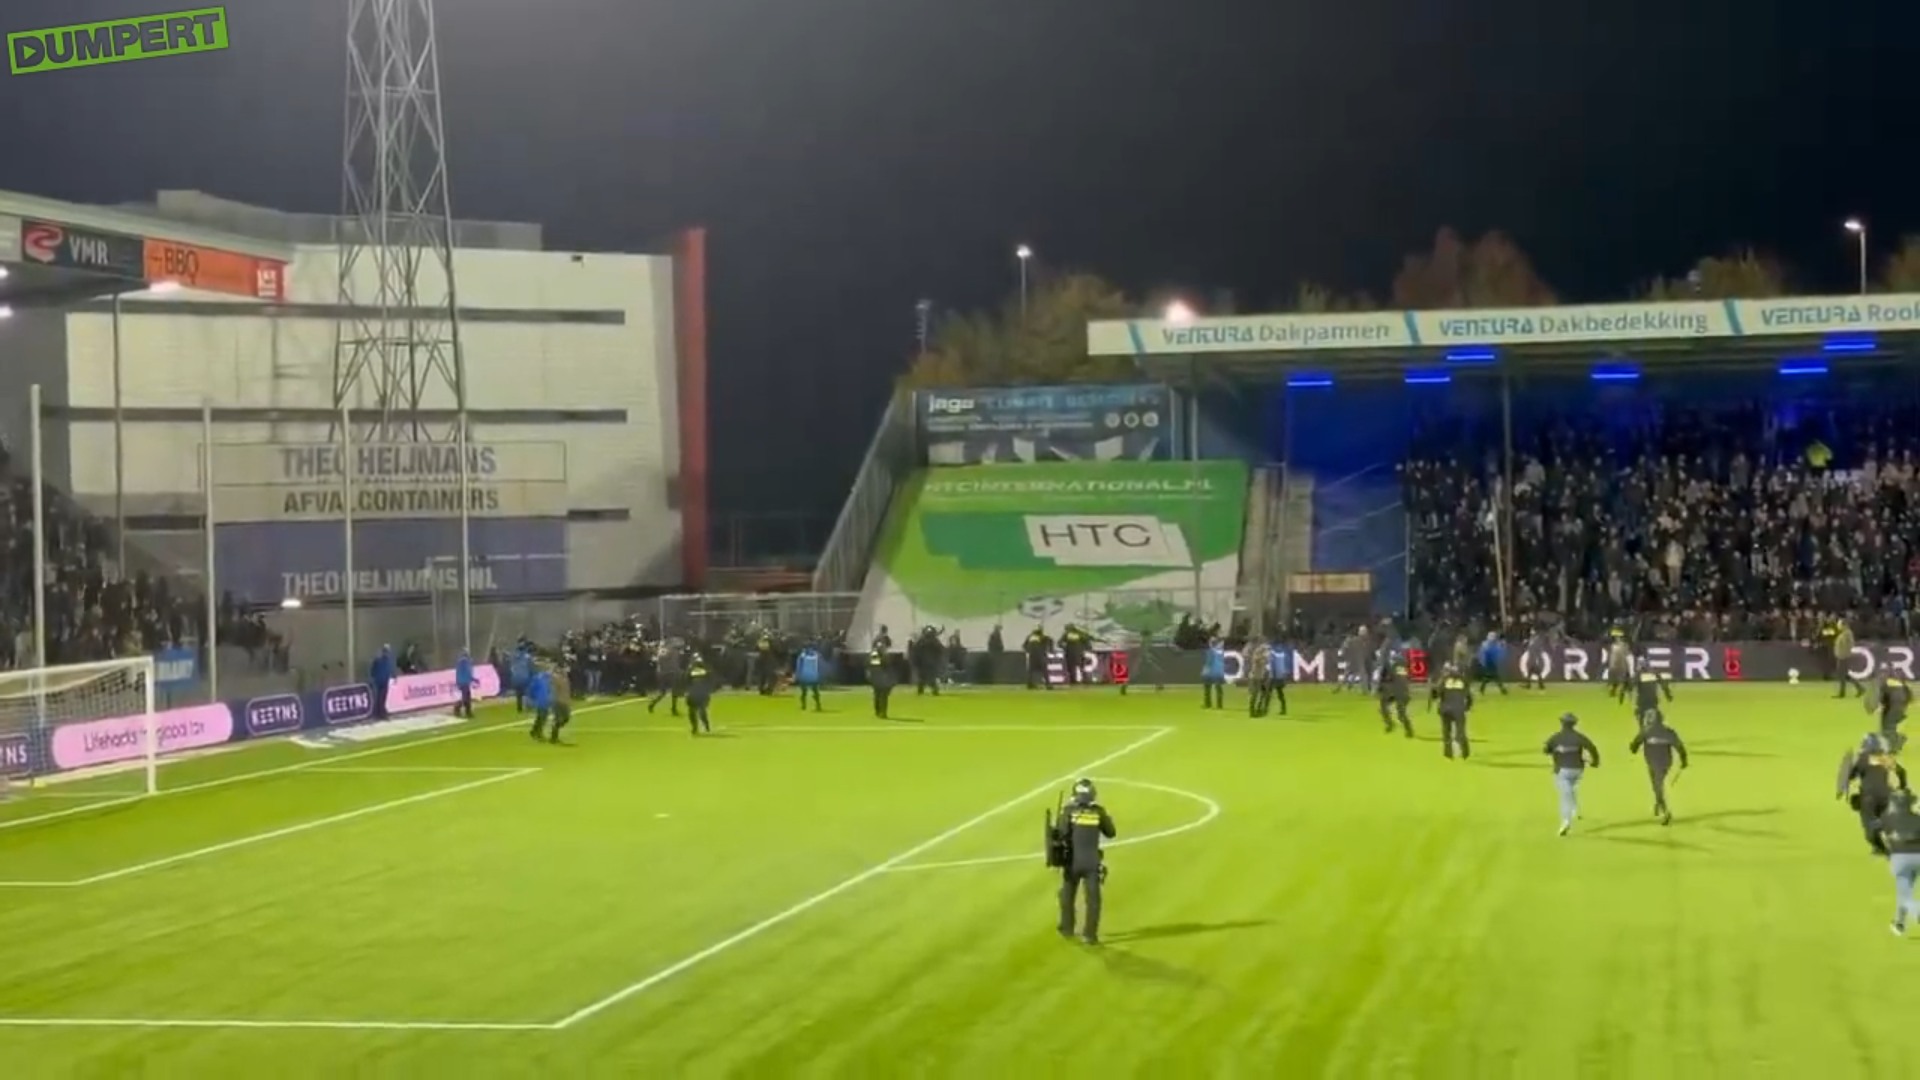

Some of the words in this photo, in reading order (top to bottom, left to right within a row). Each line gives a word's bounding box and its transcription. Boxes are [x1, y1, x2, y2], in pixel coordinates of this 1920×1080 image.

[69, 235, 109, 265] VMR
[1438, 318, 1535, 336] VENTURA
[1539, 310, 1709, 334] Dakbedekking
[1761, 305, 1862, 326] VENTURA
[1162, 325, 1254, 346] VENTURA
[1259, 323, 1390, 345] Dakpannen
[357, 446, 497, 476] HEIJMANS
[283, 489, 500, 514] AFVACONTAINERS
[1038, 523, 1152, 547] HTC
[281, 566, 499, 597] THEOHEIJMANSNL
